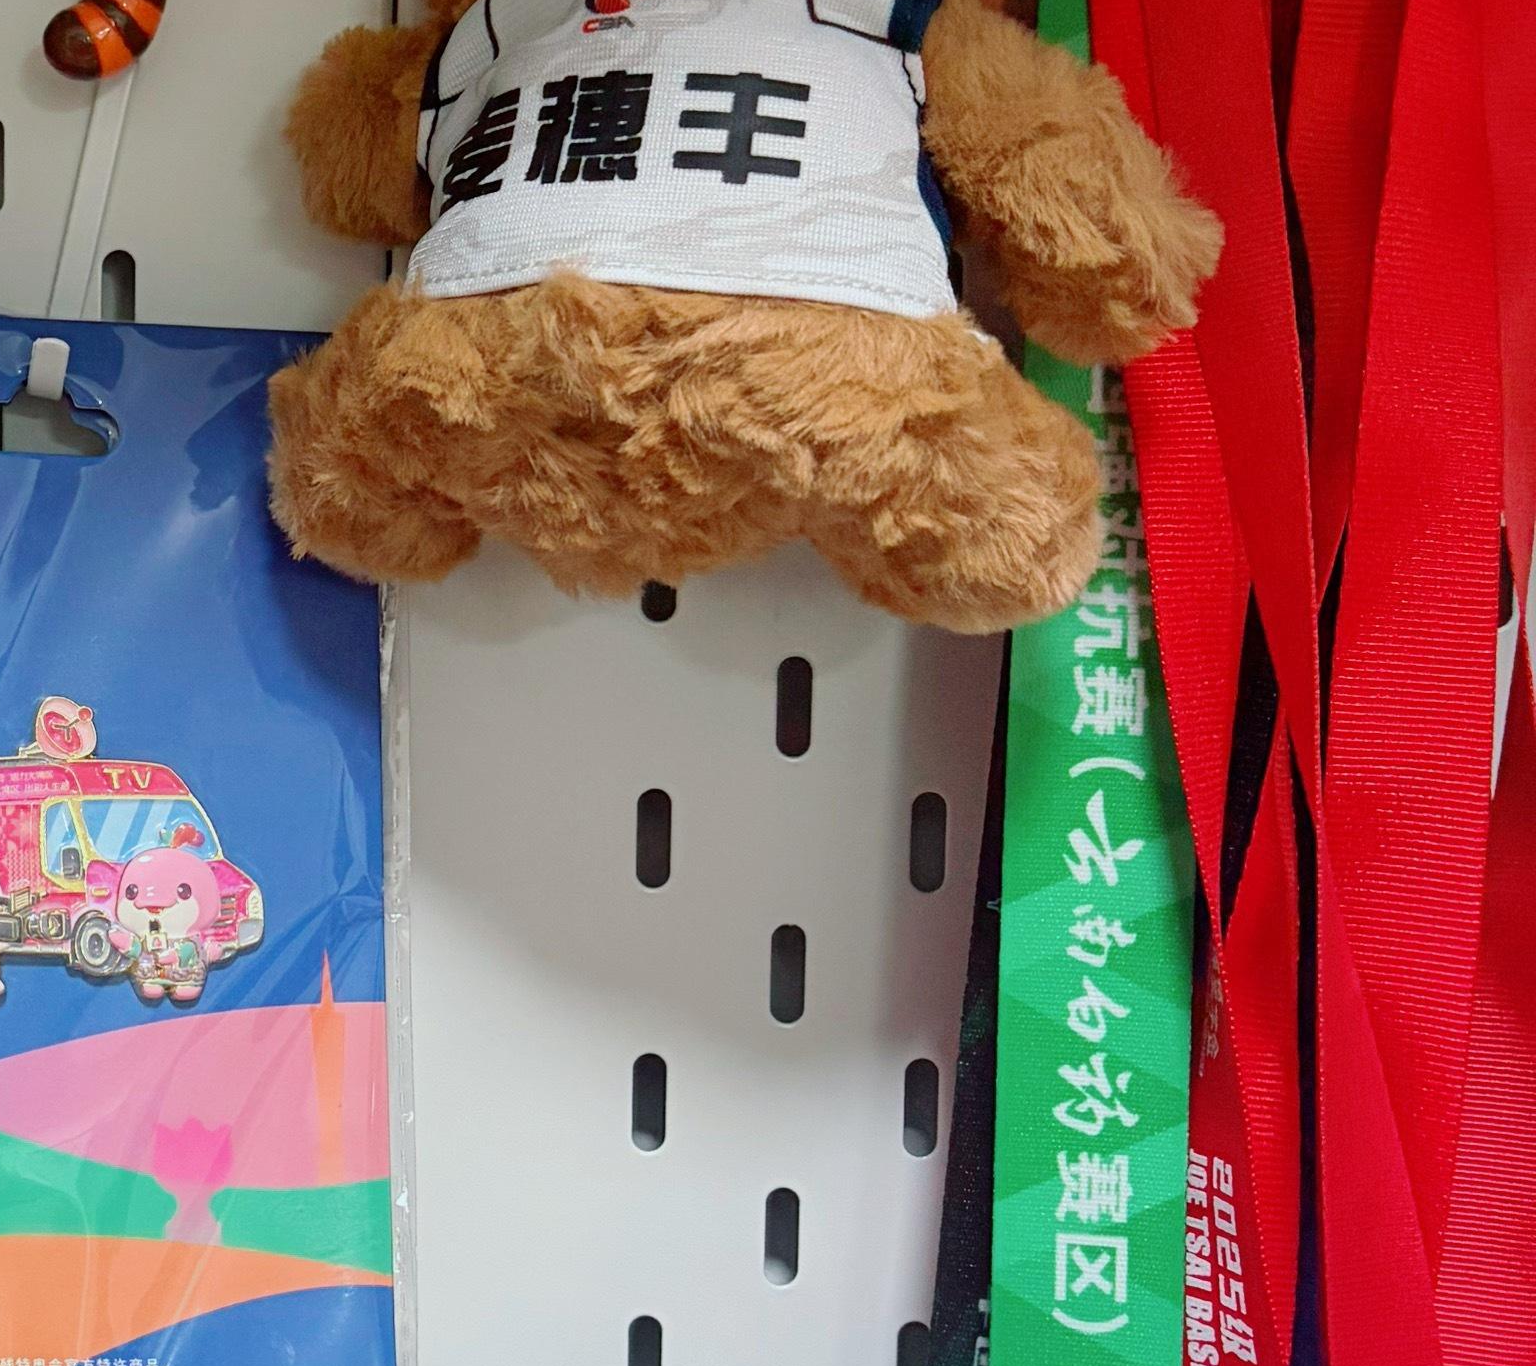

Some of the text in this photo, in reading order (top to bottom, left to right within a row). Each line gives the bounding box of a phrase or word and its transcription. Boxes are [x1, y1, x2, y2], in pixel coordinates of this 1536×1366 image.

[581, 16, 635, 34] CBA
[103, 767, 152, 790] TV
[1187, 1146, 1209, 1205] JOE
[1185, 1204, 1213, 1293] TSAI
[1212, 1154, 1258, 1366] 2025级
